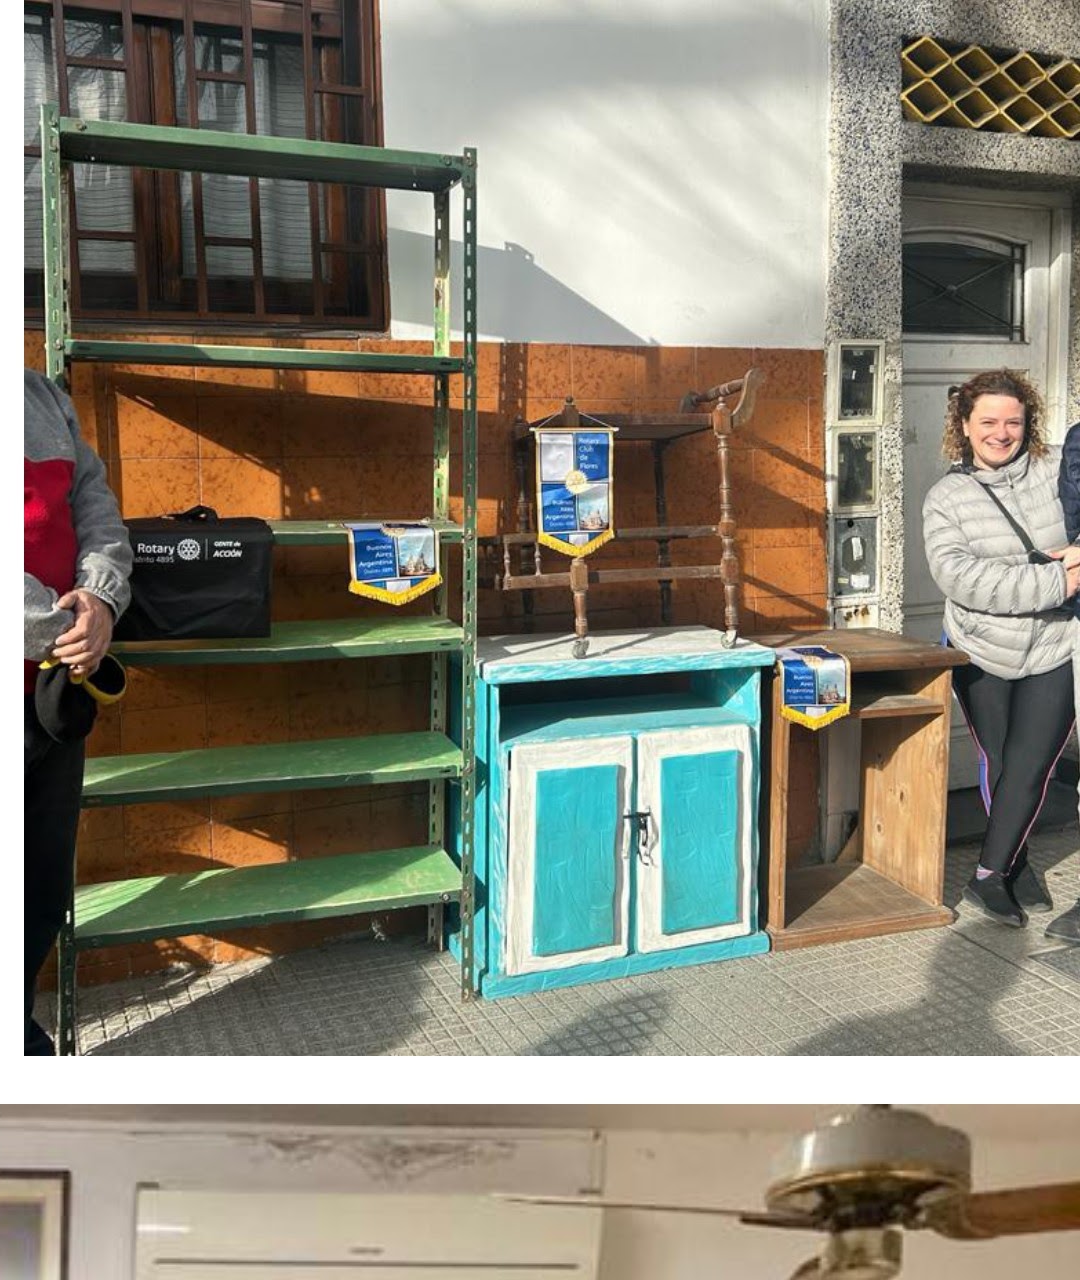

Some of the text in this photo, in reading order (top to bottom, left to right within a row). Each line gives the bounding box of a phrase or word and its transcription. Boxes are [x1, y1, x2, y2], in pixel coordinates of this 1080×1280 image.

[137, 543, 175, 555] Rotary
[213, 549, 242, 558] ACCIÓN
[359, 560, 393, 569] Argentina
